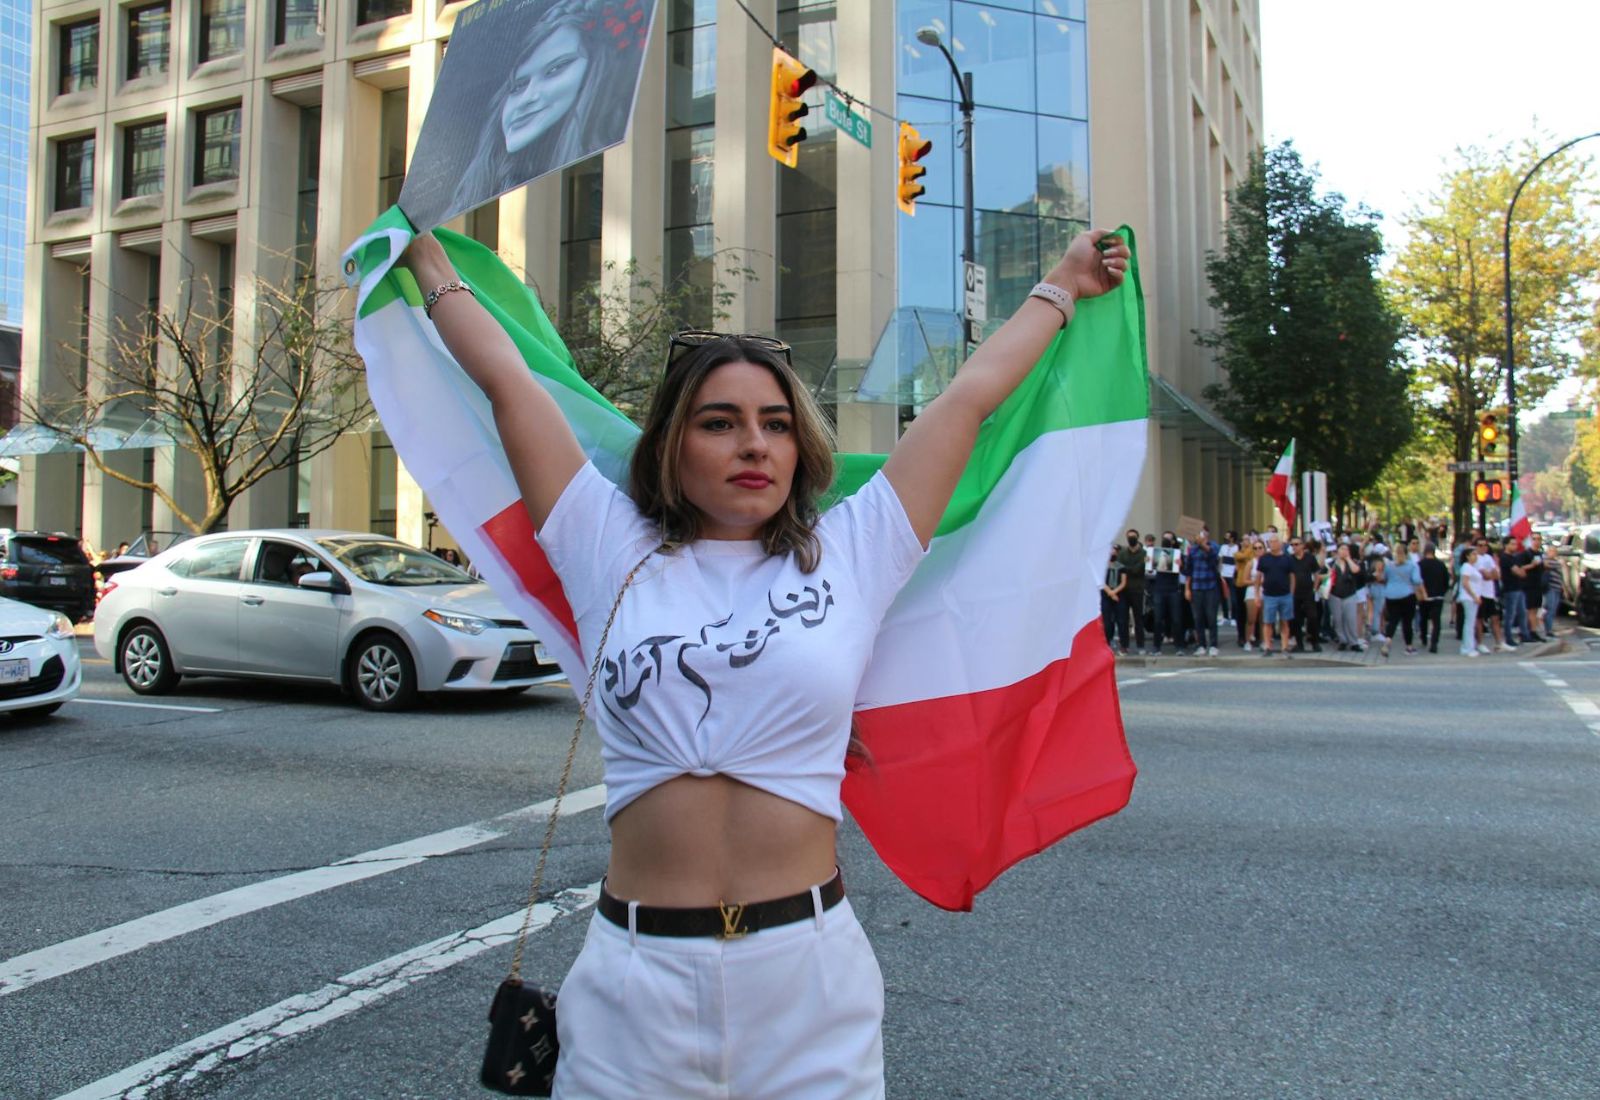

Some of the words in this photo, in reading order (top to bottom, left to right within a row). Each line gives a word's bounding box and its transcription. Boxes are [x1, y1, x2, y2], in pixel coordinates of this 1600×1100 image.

[829, 99, 853, 132] Bute
[856, 120, 868, 143] St
[768, 579, 834, 629] زن
